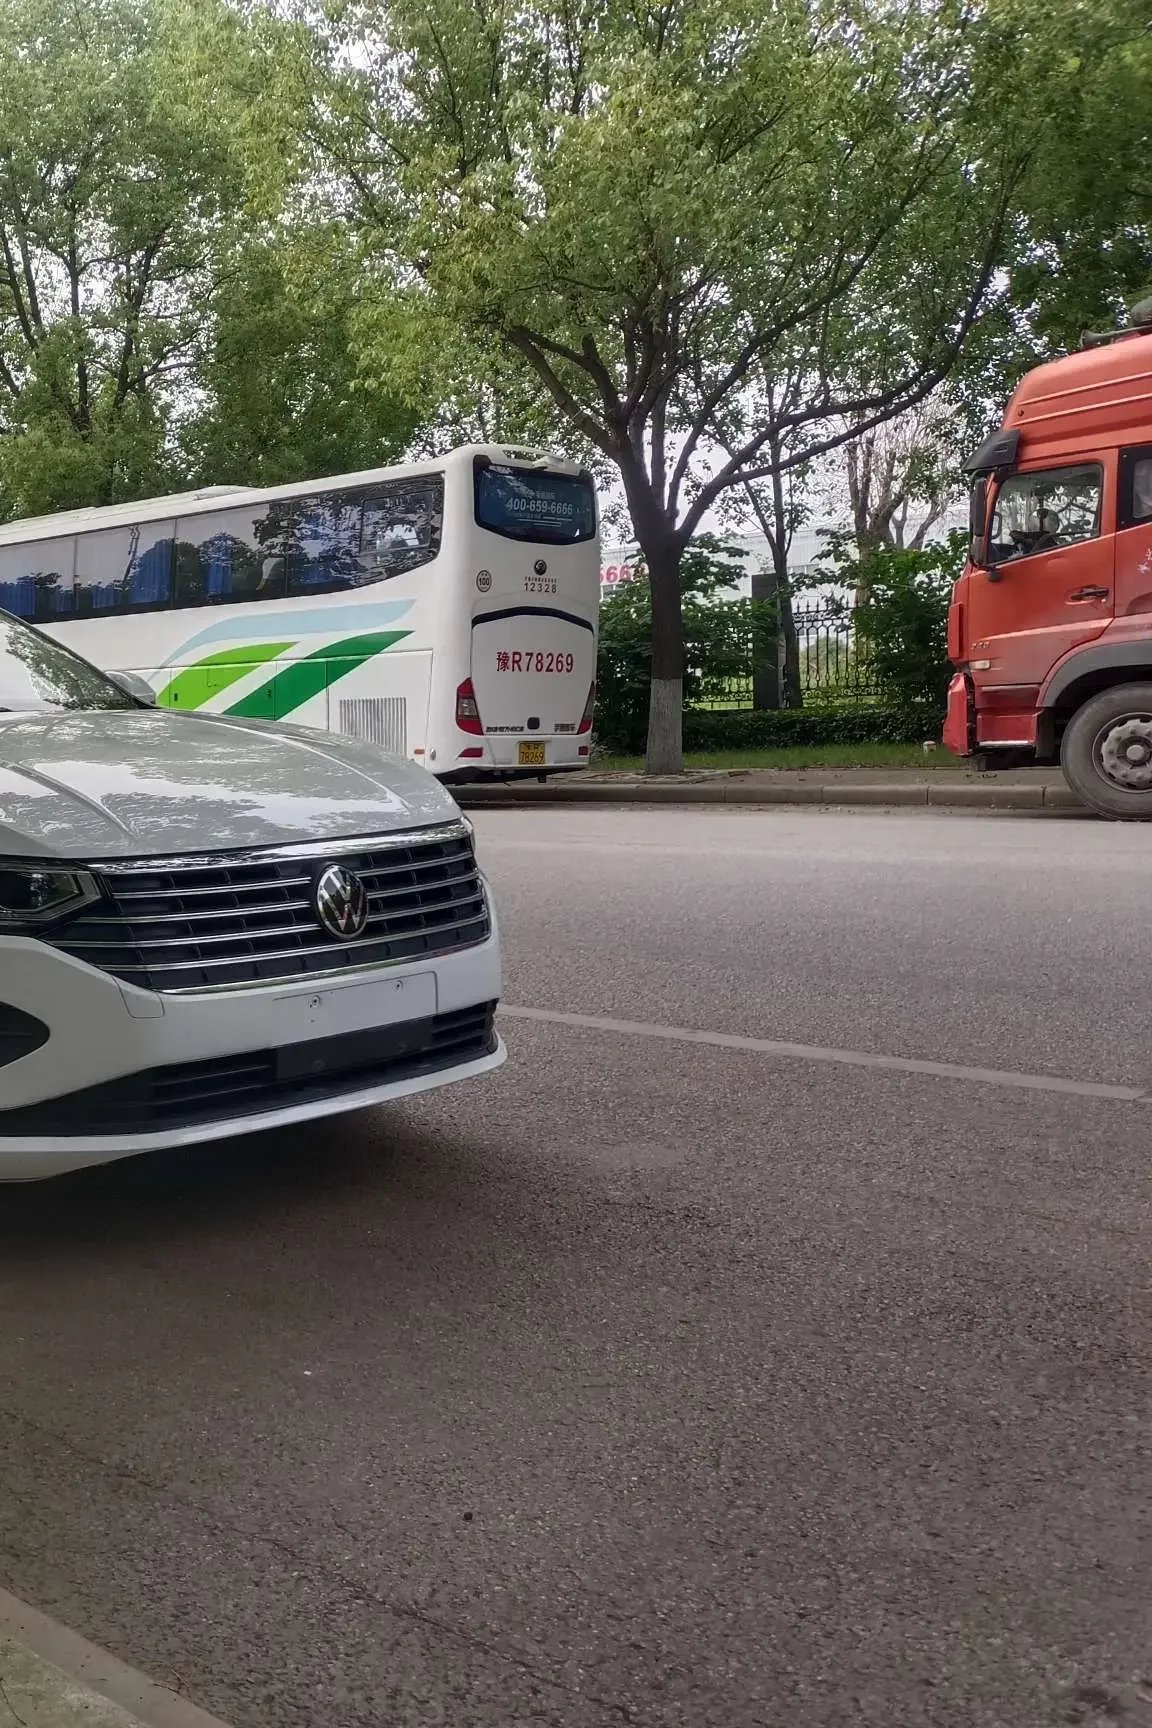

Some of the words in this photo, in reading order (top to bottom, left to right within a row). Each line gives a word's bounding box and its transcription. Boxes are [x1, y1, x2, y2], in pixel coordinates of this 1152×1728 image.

[479, 577, 489, 586] 100
[524, 582, 557, 593] 12328
[496, 651, 574, 672] 豫R78269
